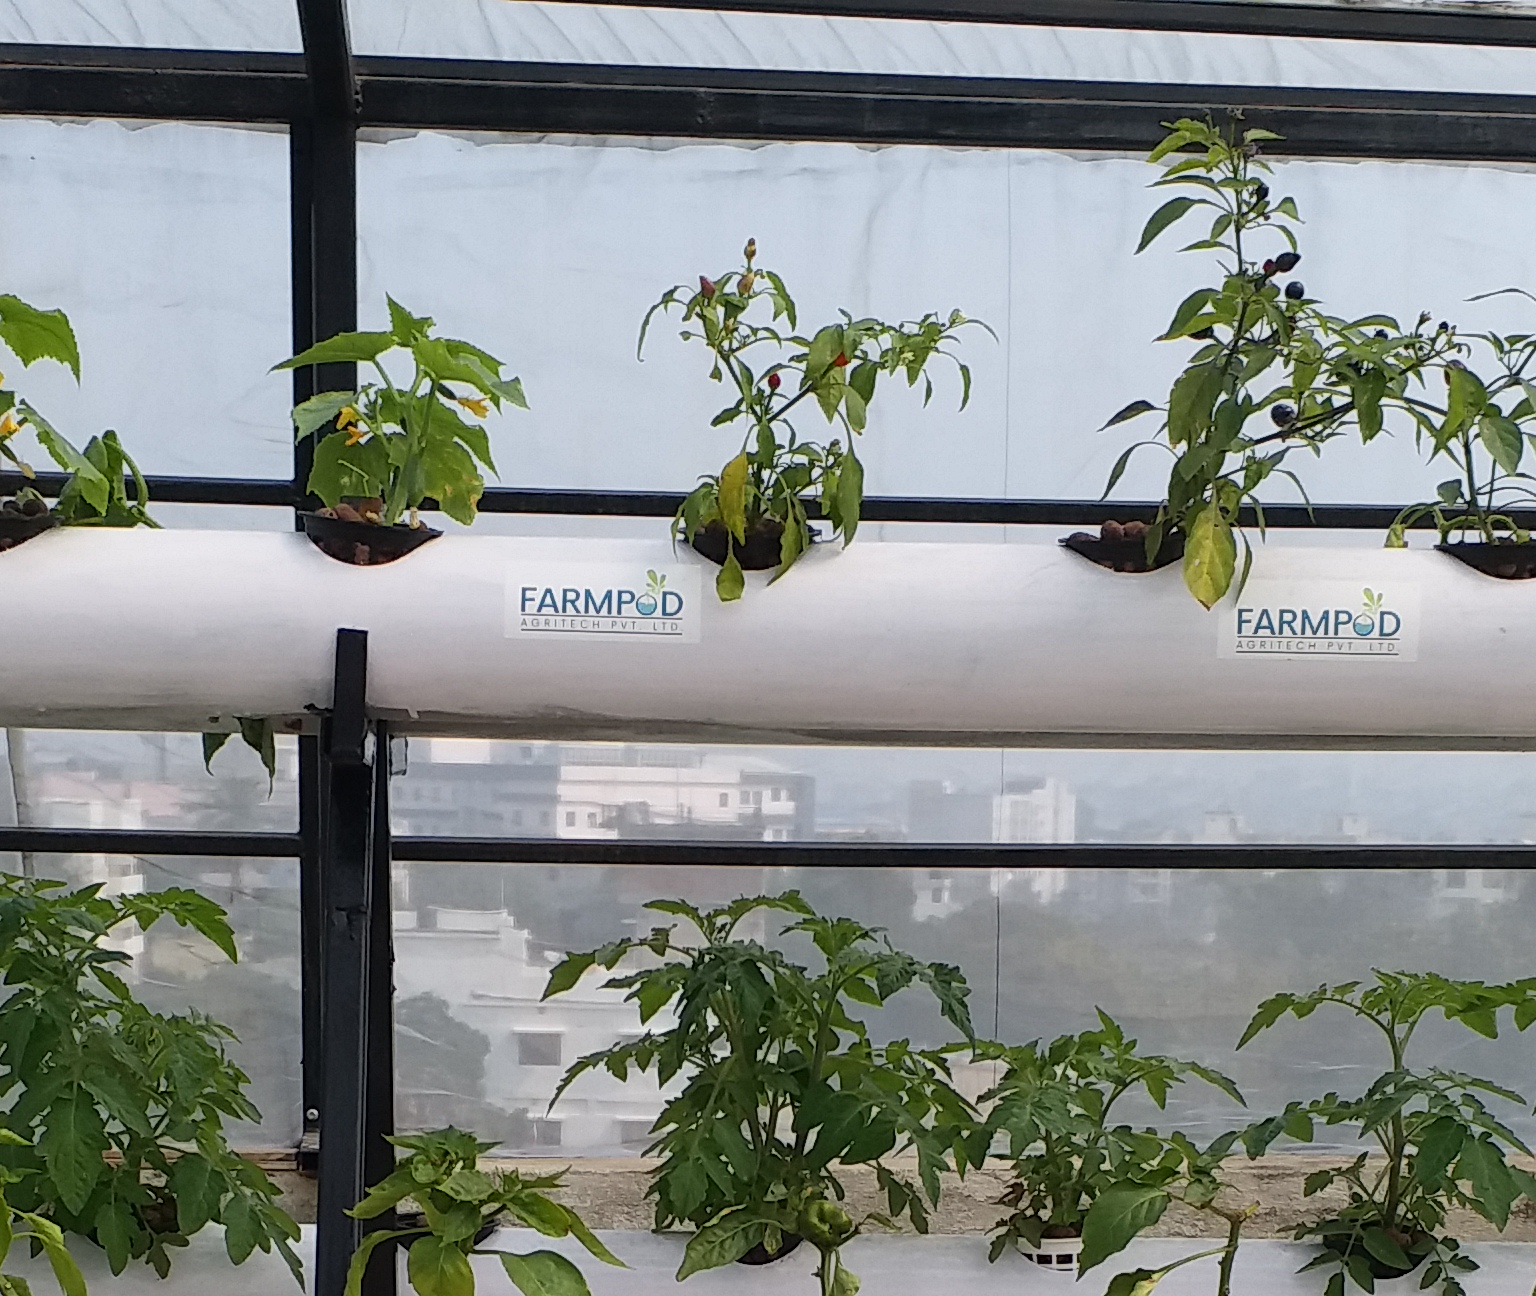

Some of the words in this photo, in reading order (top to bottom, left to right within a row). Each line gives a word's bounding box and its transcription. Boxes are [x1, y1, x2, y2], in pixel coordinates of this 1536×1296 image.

[521, 587, 683, 616] FARMPOD
[521, 618, 600, 629] AGRITECH
[1237, 609, 1400, 636] FARMPOD
[1236, 641, 1316, 650] AGRITECH
